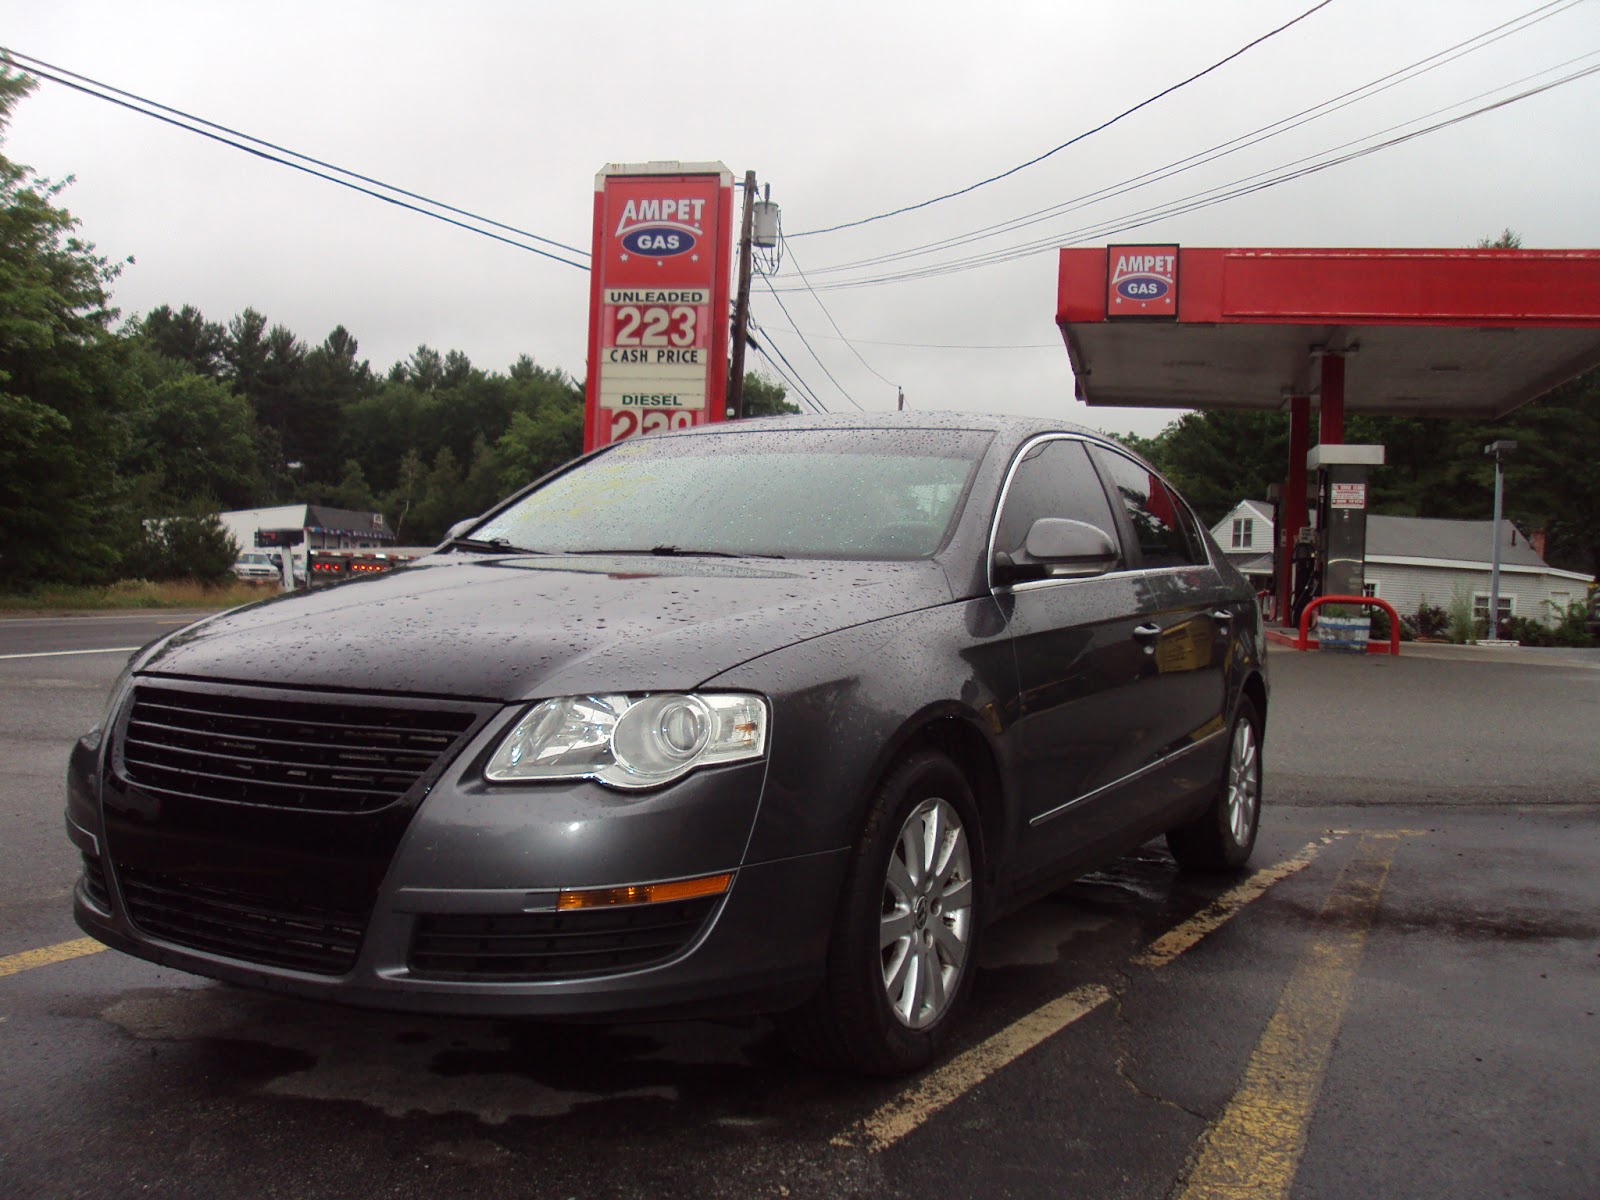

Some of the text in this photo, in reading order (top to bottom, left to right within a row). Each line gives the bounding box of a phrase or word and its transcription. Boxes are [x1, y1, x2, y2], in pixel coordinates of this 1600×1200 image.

[614, 198, 705, 236] AMPET
[637, 235, 680, 249] GAS
[1111, 255, 1175, 283] AMPET
[1127, 283, 1158, 294] GAS
[610, 292, 703, 302] UNLEADED
[615, 306, 697, 346] 223
[610, 349, 698, 363] CASH PRICE
[622, 395, 683, 406] DIESEL
